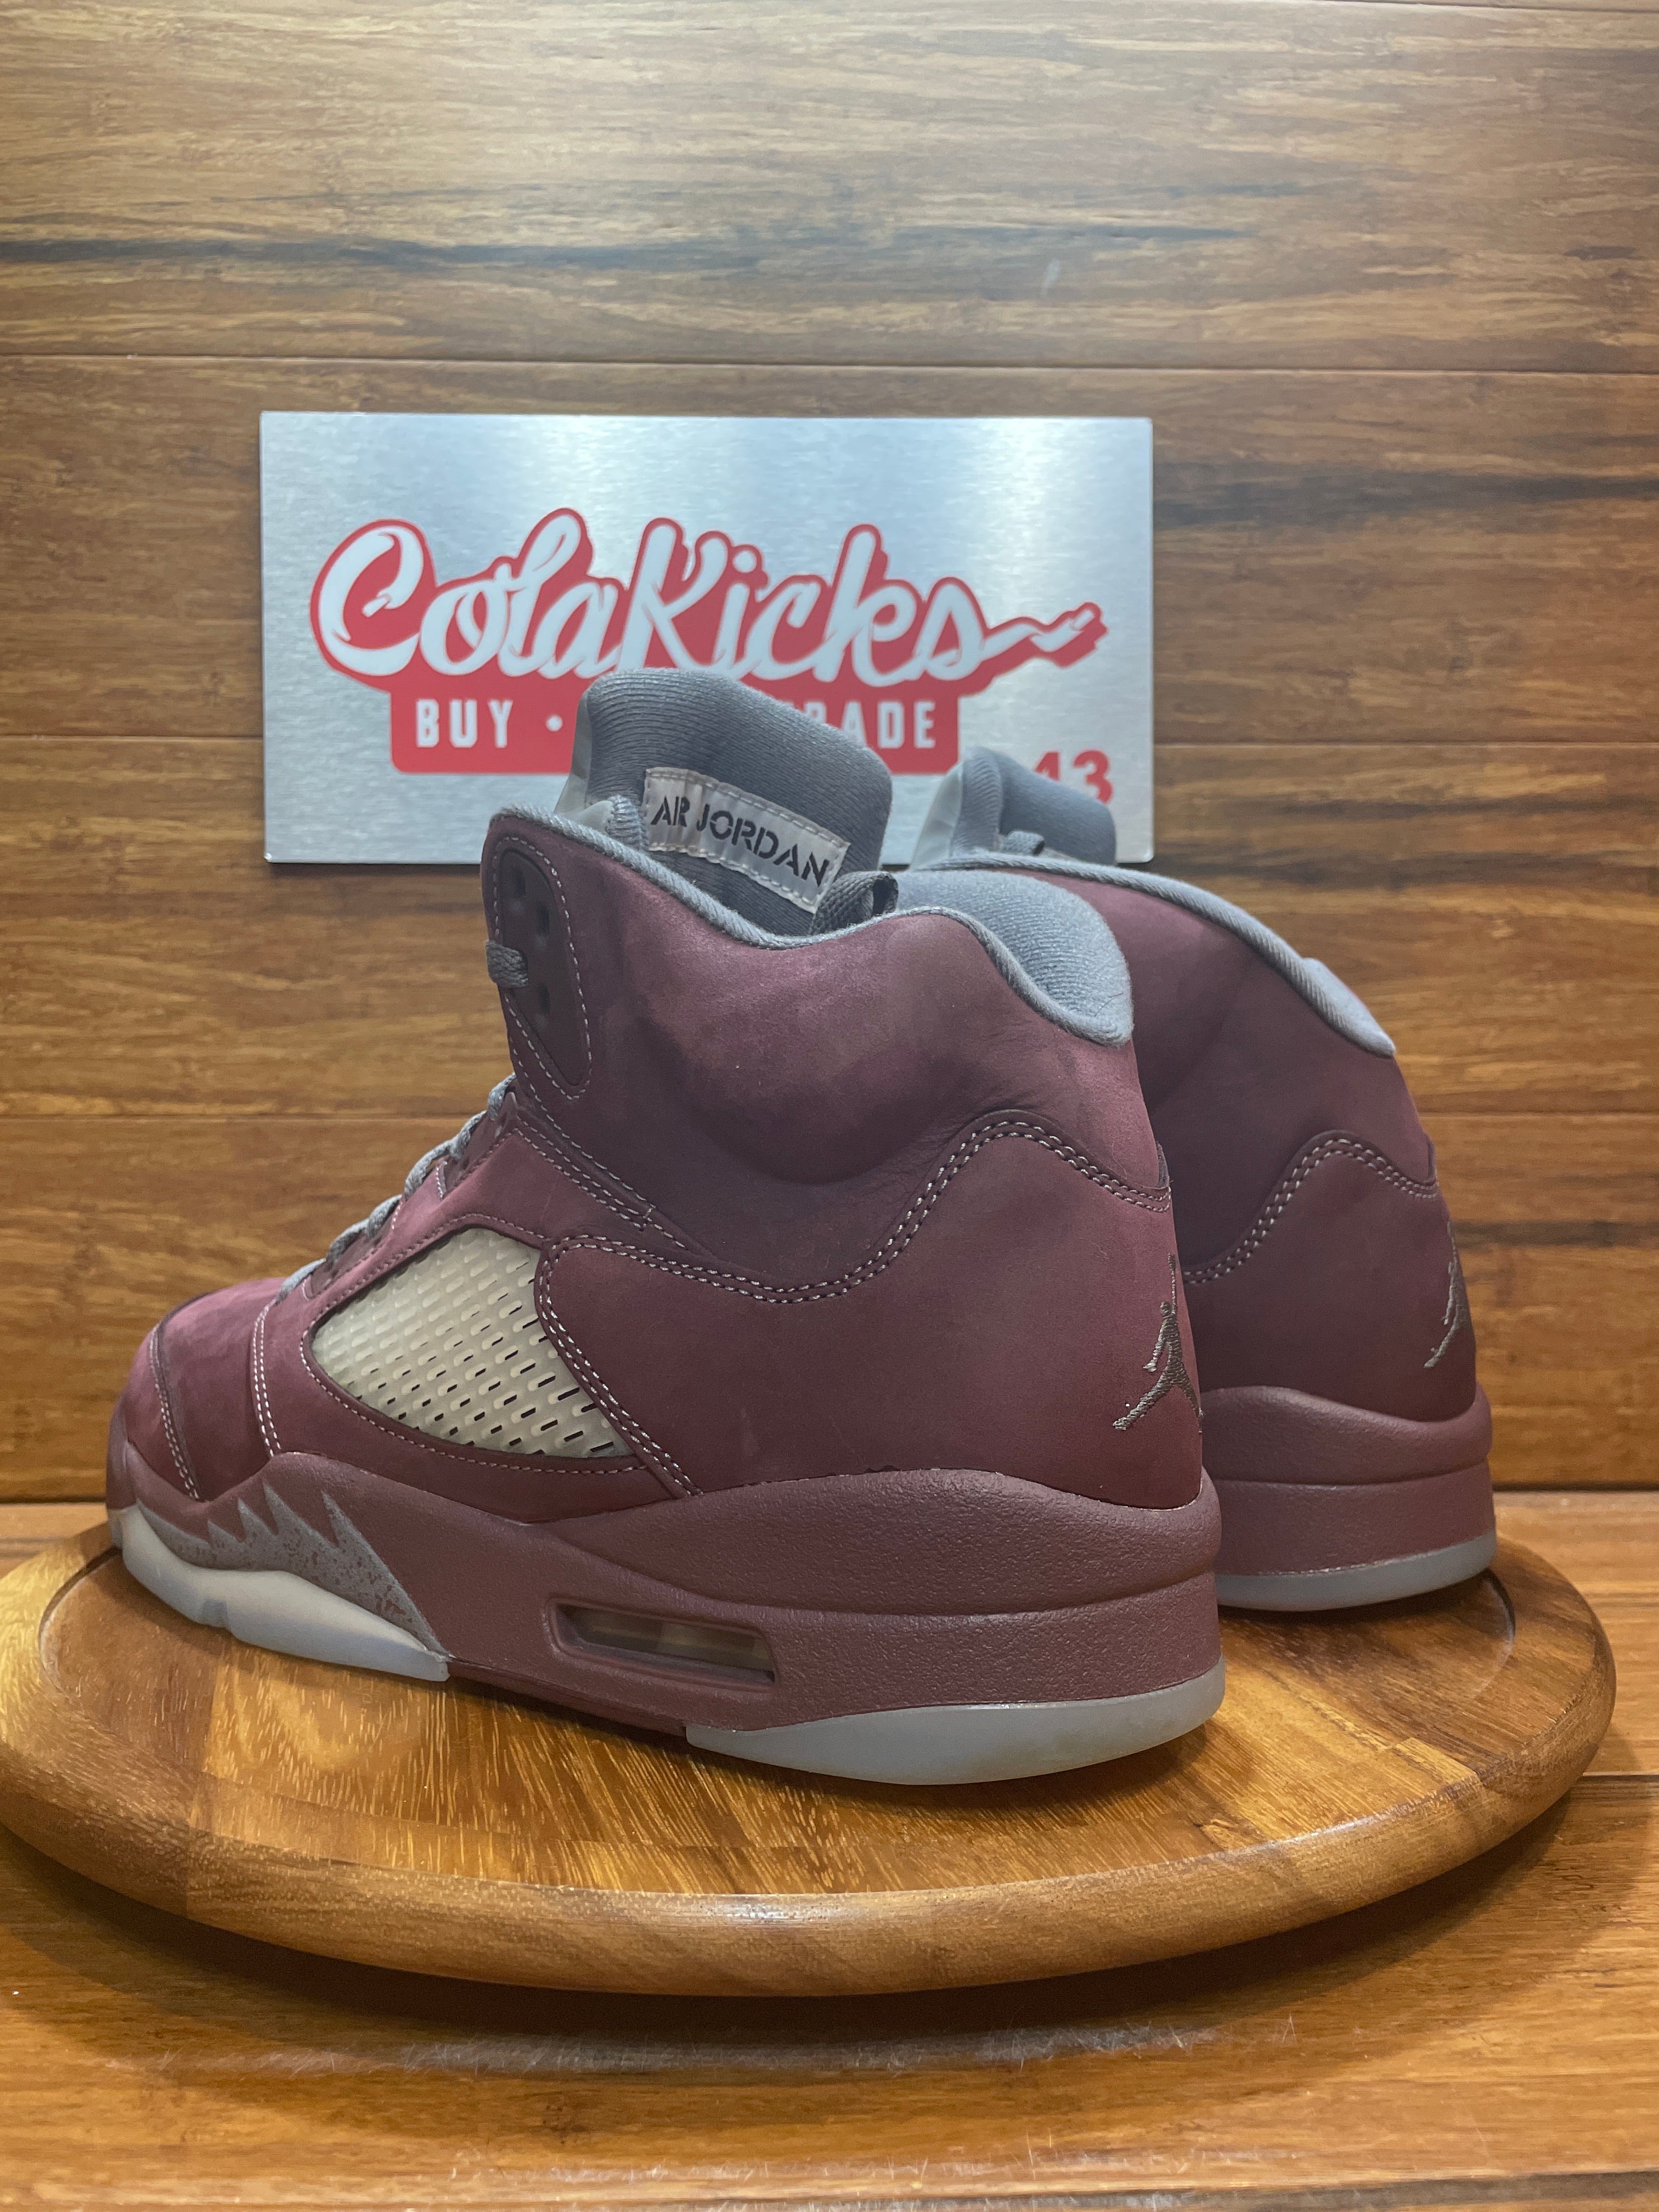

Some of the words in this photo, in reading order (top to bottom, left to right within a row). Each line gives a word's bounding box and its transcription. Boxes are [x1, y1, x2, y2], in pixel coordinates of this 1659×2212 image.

[415, 698, 514, 748] BUY
[785, 699, 936, 749] ADE
[650, 795, 691, 827] AIR
[696, 803, 830, 888] JORDAN
